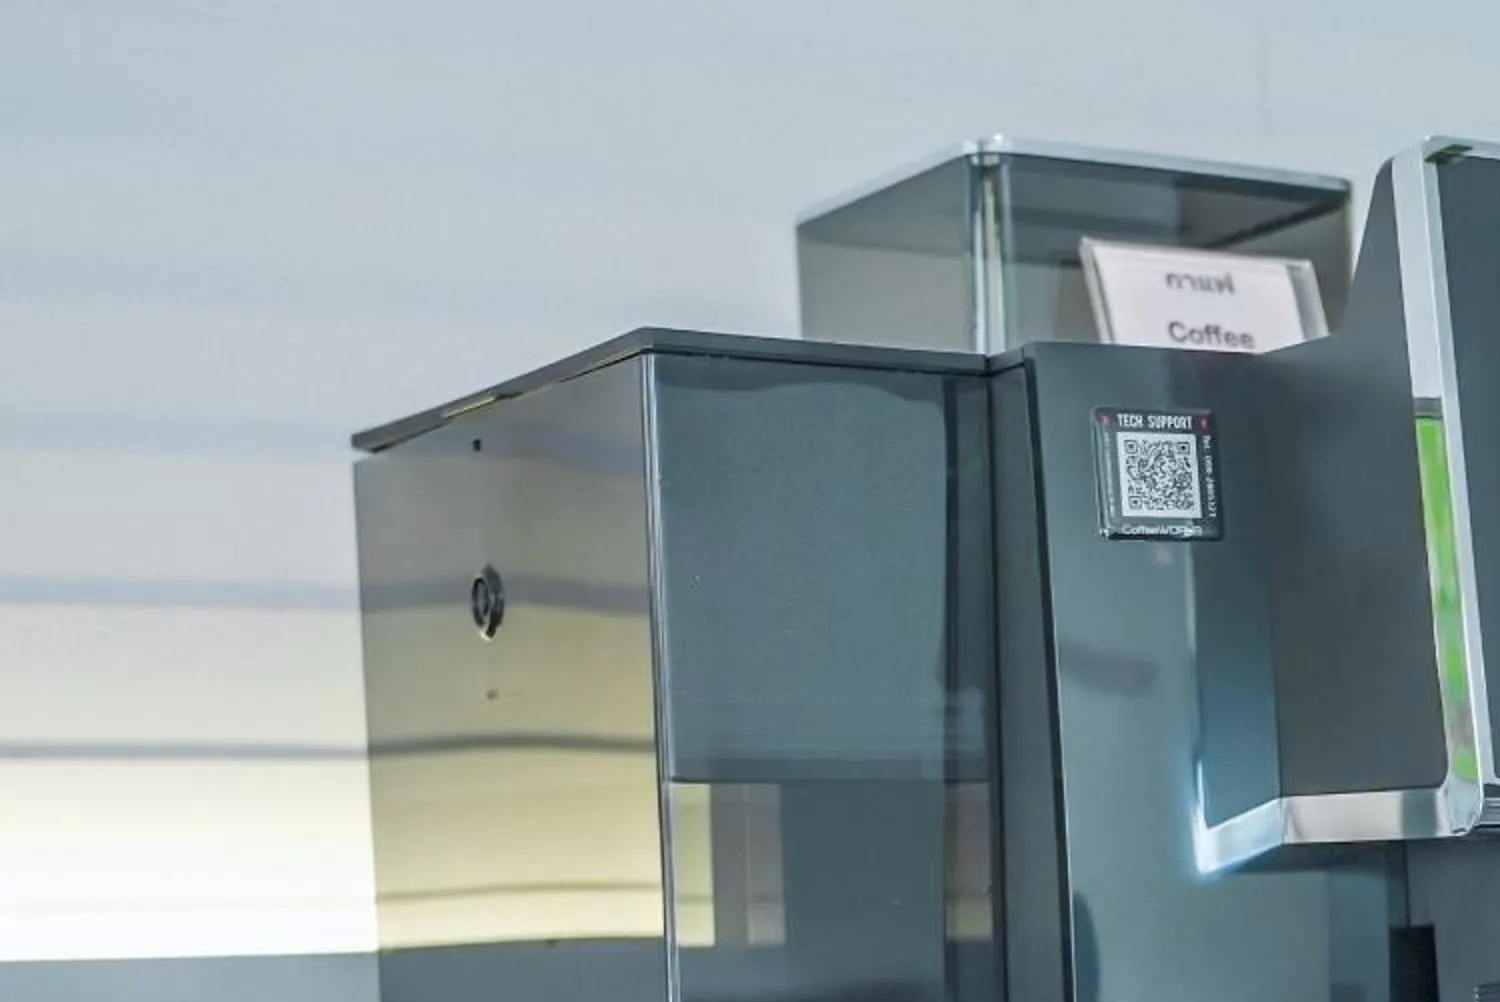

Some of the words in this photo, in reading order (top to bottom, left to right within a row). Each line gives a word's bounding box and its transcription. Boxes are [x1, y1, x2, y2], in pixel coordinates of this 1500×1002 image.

[1168, 321, 1255, 349] Coffee
[1117, 413, 1143, 428] TECH
[1147, 415, 1193, 429] SUPPORT
